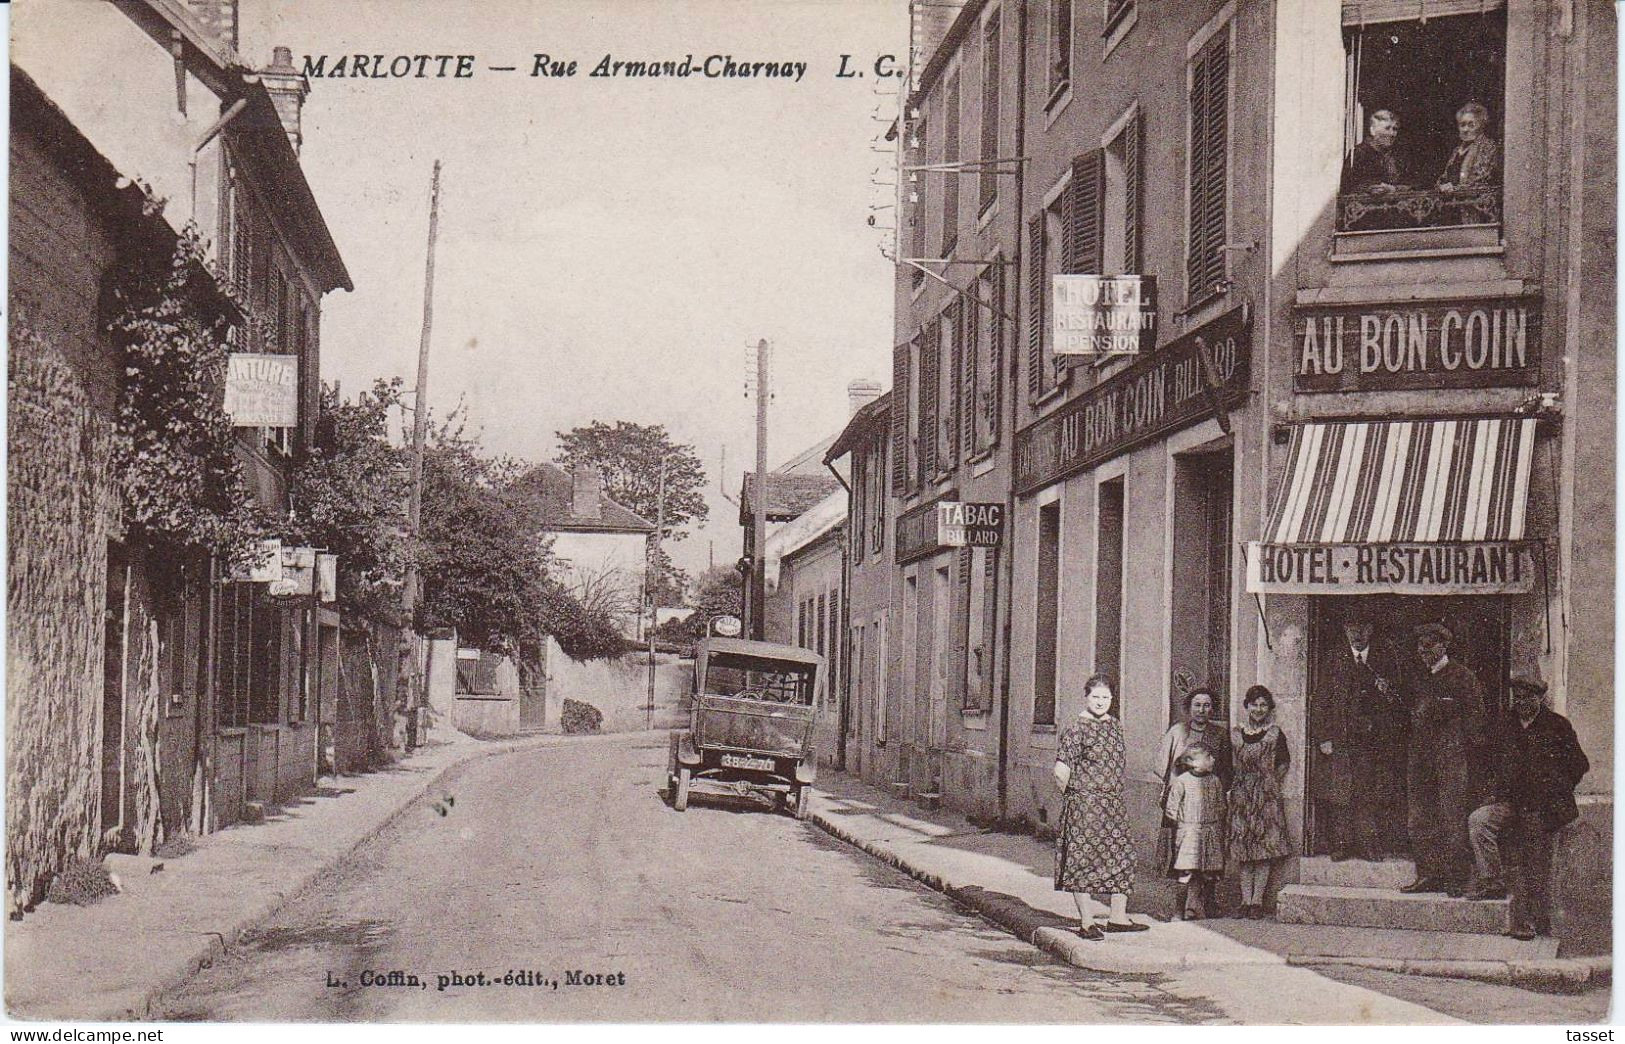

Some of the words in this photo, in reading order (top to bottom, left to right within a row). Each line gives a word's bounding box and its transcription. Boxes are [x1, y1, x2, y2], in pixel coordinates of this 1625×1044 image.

[1063, 280, 1150, 306] HOTEL
[1057, 311, 1156, 330] RESTAURANT
[1067, 335, 1140, 351] PENSION
[1301, 316, 1344, 375] AU
[1360, 313, 1428, 373] BON
[1440, 309, 1527, 370] COIN
[1060, 411, 1079, 464] AU
[1085, 391, 1117, 452] BON
[1123, 362, 1166, 434] COIN
[1175, 337, 1236, 405] BILLRD
[942, 504, 1000, 526] TABAC
[946, 529, 999, 544] BILLARD
[1259, 545, 1339, 583] HOTEL
[1355, 545, 1526, 584] RESTAURANT
